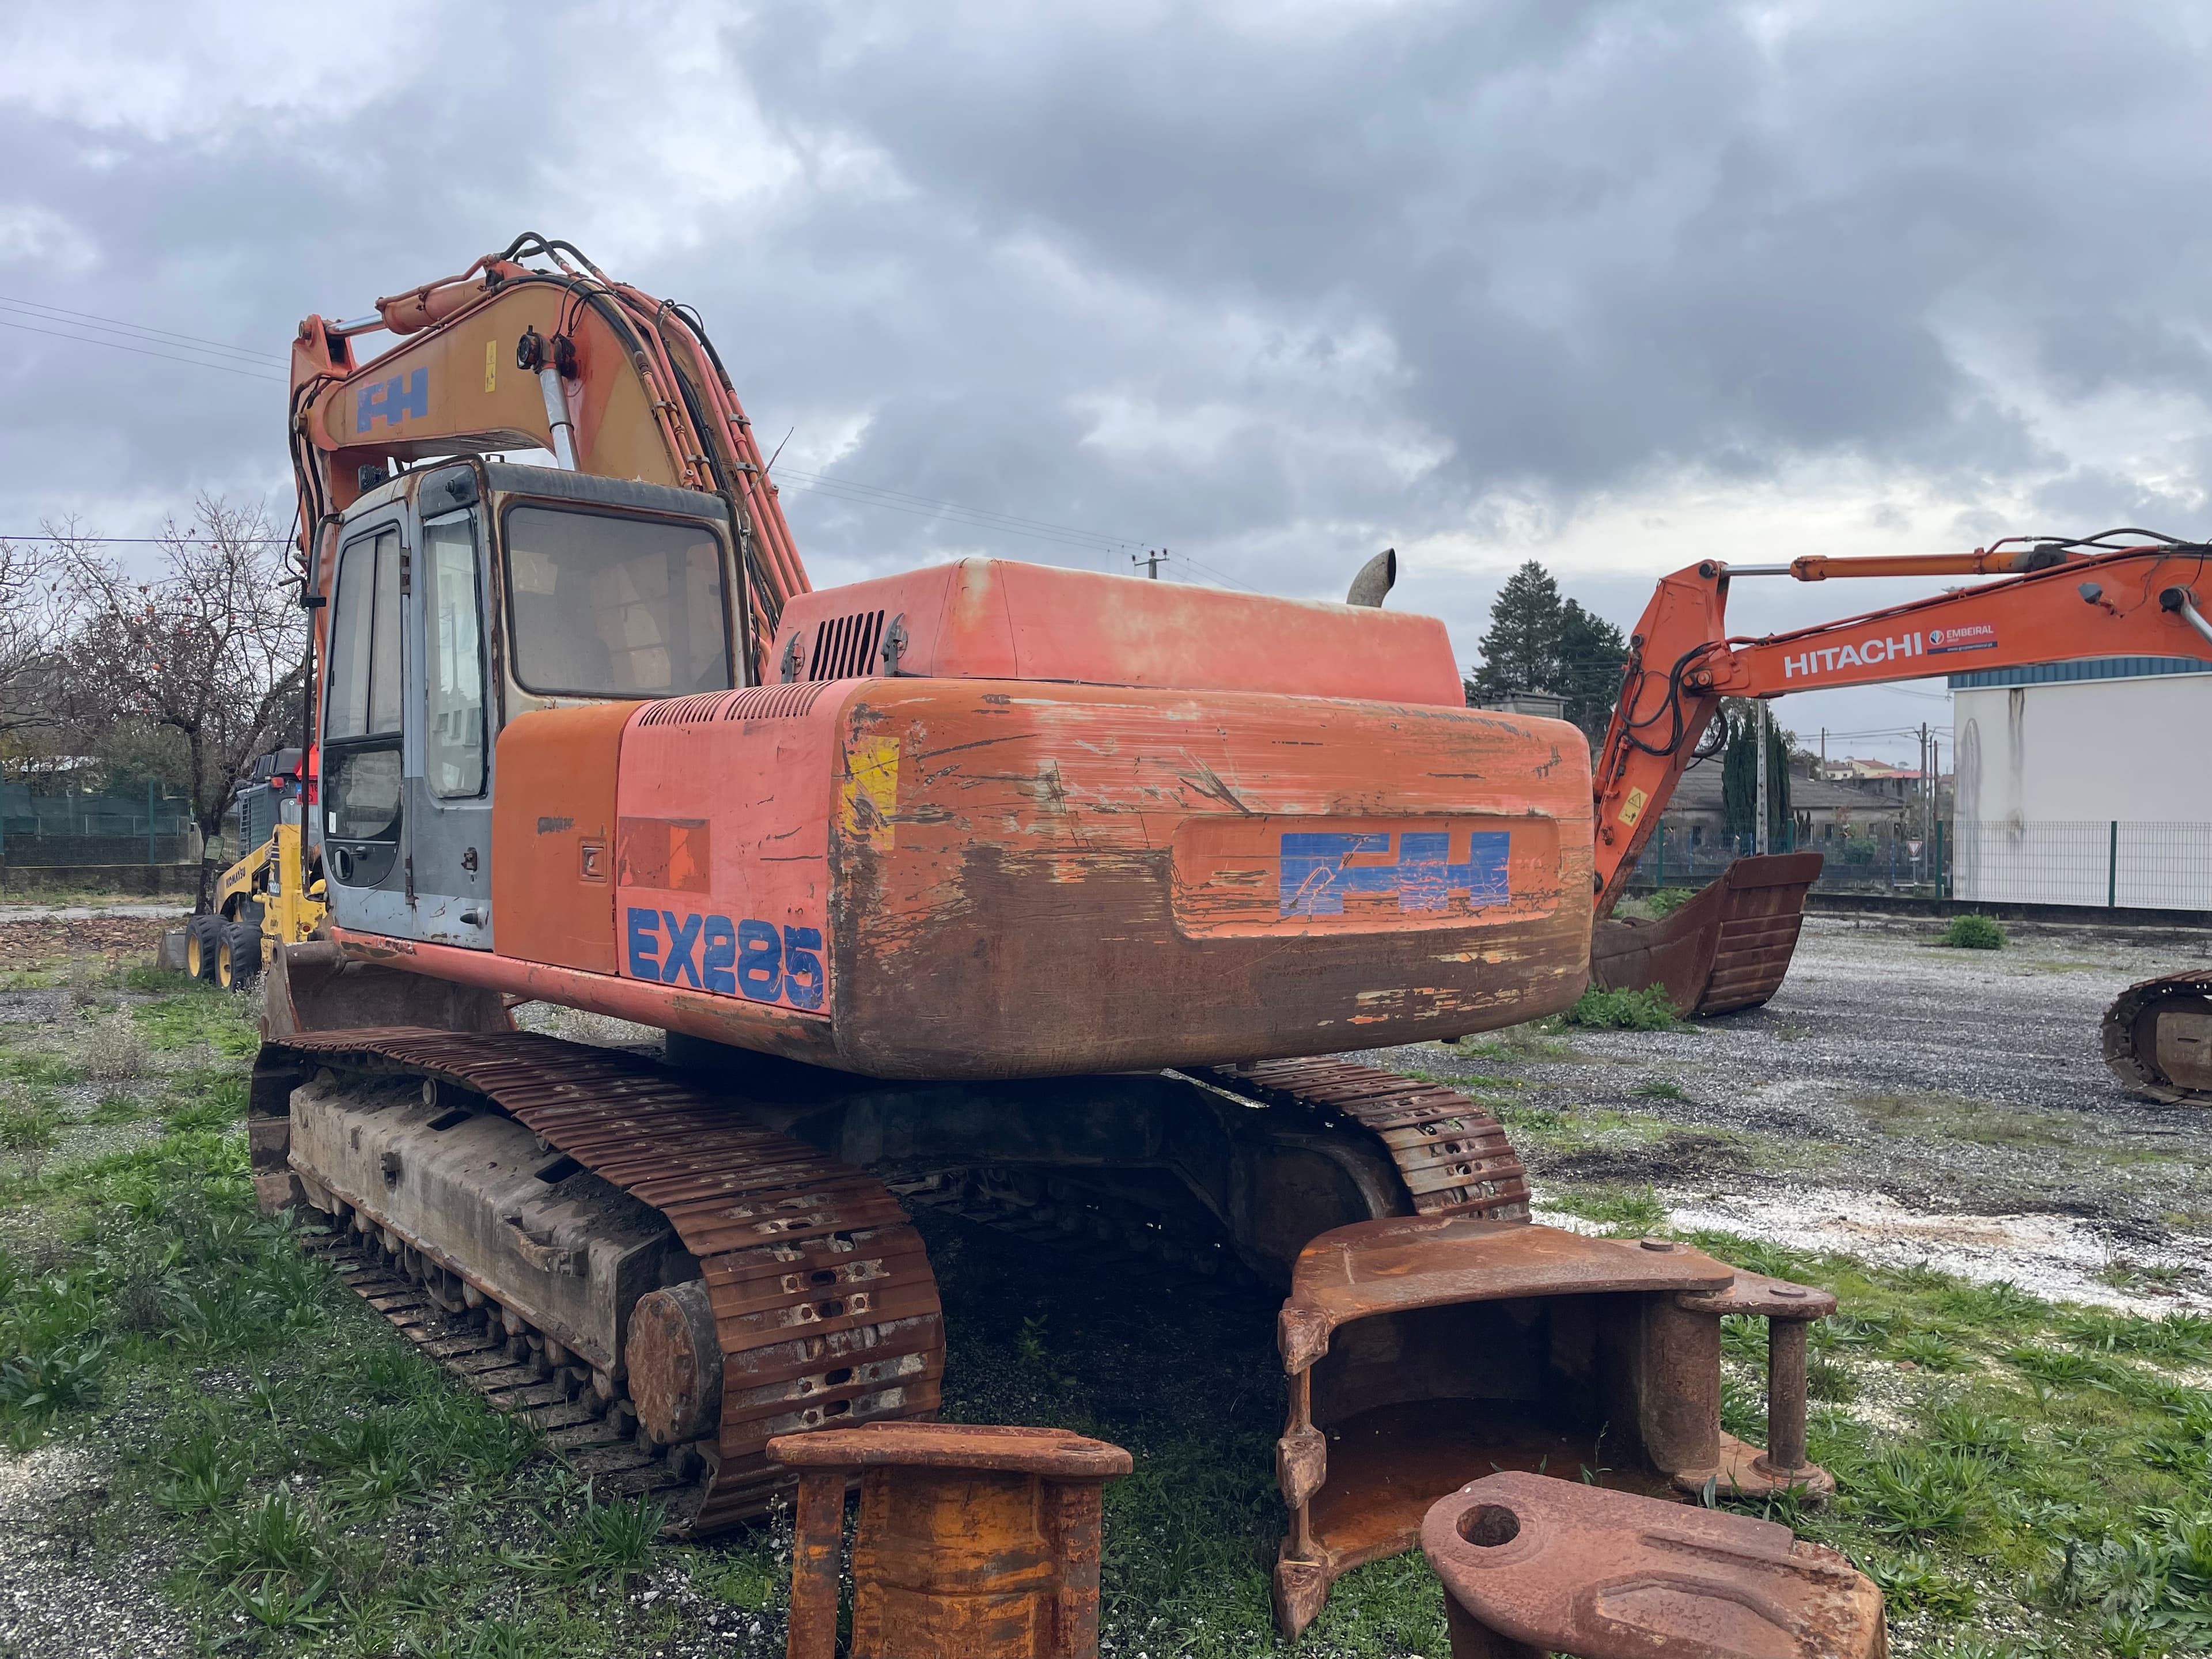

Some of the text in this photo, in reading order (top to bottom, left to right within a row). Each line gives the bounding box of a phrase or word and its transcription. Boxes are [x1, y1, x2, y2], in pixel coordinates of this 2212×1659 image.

[1946, 625, 1994, 639] EMBEIRAL
[1784, 632, 1923, 678] HITACHI
[225, 866, 247, 889] KOMATSU
[627, 907, 824, 1010] EX285
